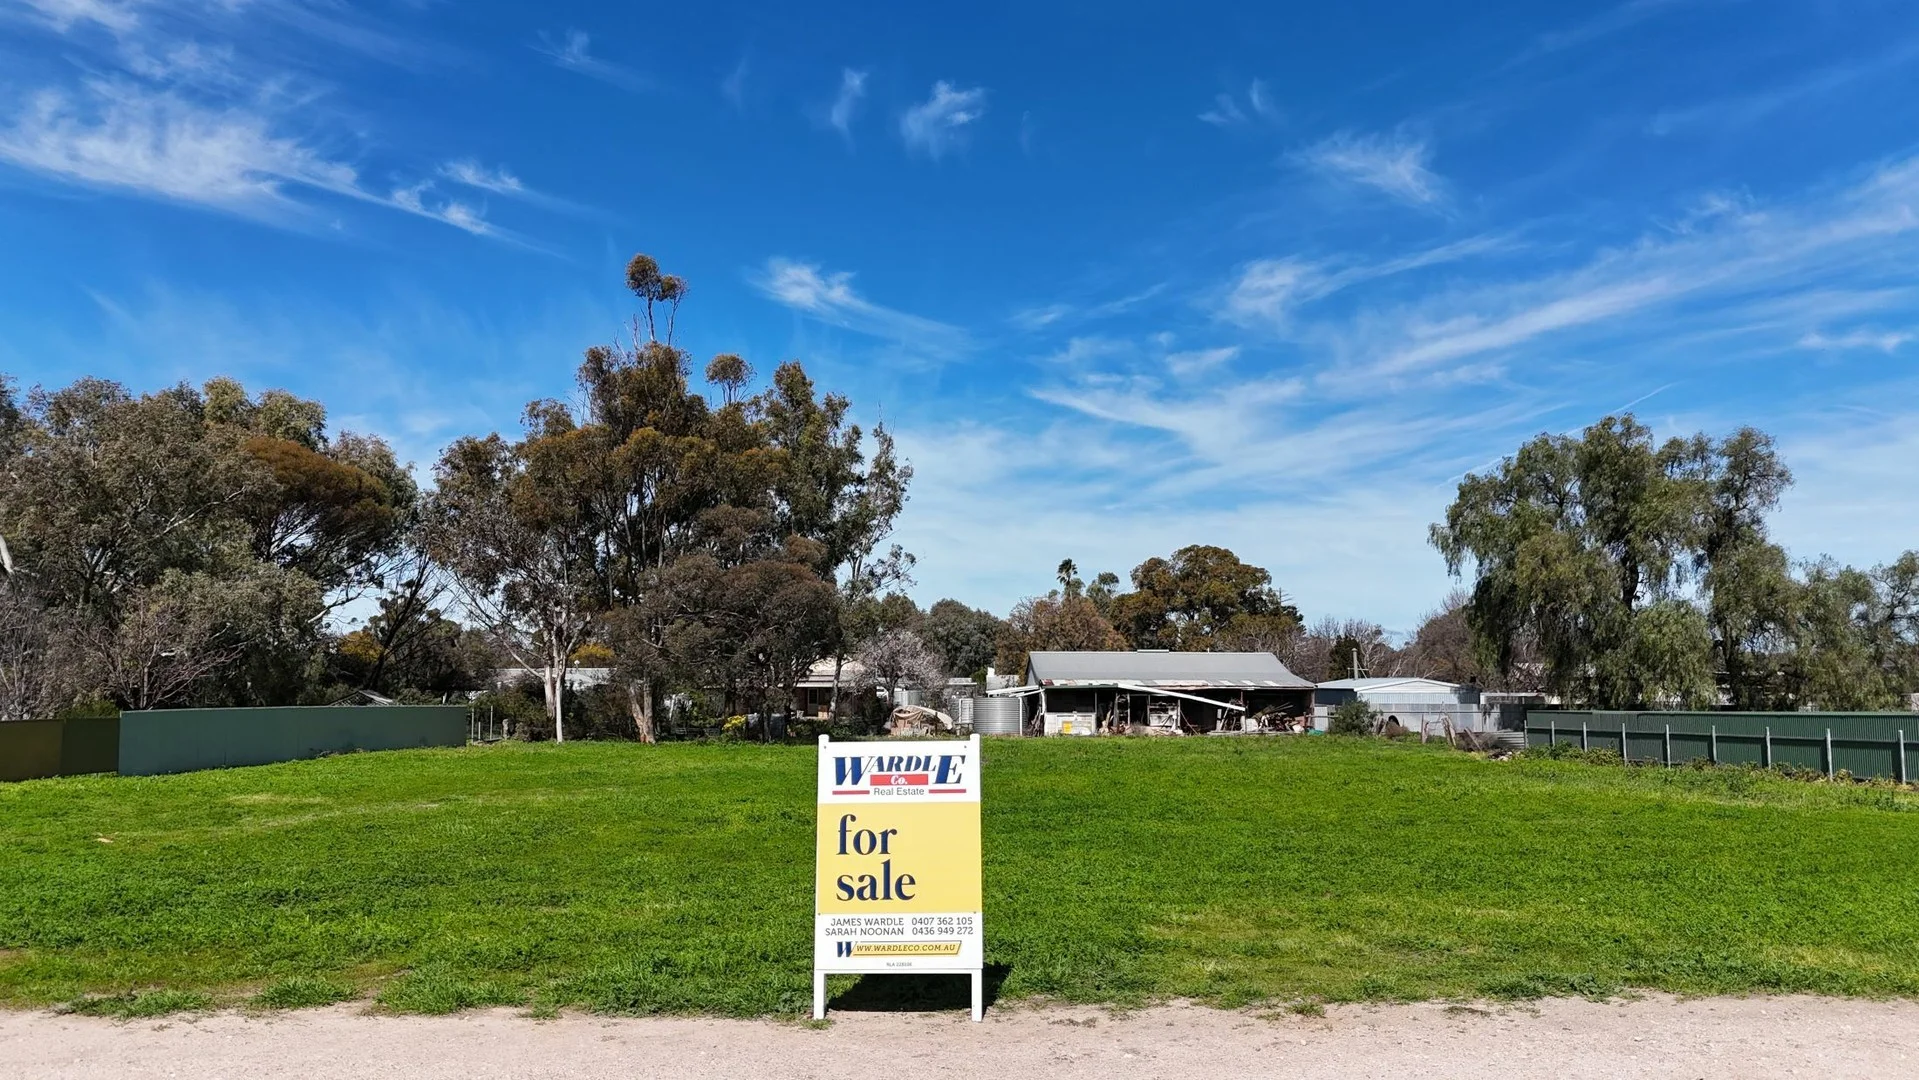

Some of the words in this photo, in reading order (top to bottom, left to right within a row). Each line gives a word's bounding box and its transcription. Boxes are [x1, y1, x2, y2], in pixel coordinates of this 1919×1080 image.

[833, 755, 966, 785] WARDLE
[890, 774, 908, 785] Co.
[873, 787, 894, 796] Real
[897, 787, 925, 796] Estate
[836, 814, 898, 855] for
[836, 859, 916, 901] sale
[831, 918, 862, 926] JAMES
[864, 917, 904, 926] WARDLE
[912, 917, 934, 926] 0407
[937, 917, 953, 925] 362
[956, 917, 973, 925] 105
[825, 928, 857, 936] SARAH
[860, 927, 904, 936] NOONAN
[912, 927, 935, 935] 0436
[938, 927, 954, 935] 949
[957, 927, 973, 935] 272
